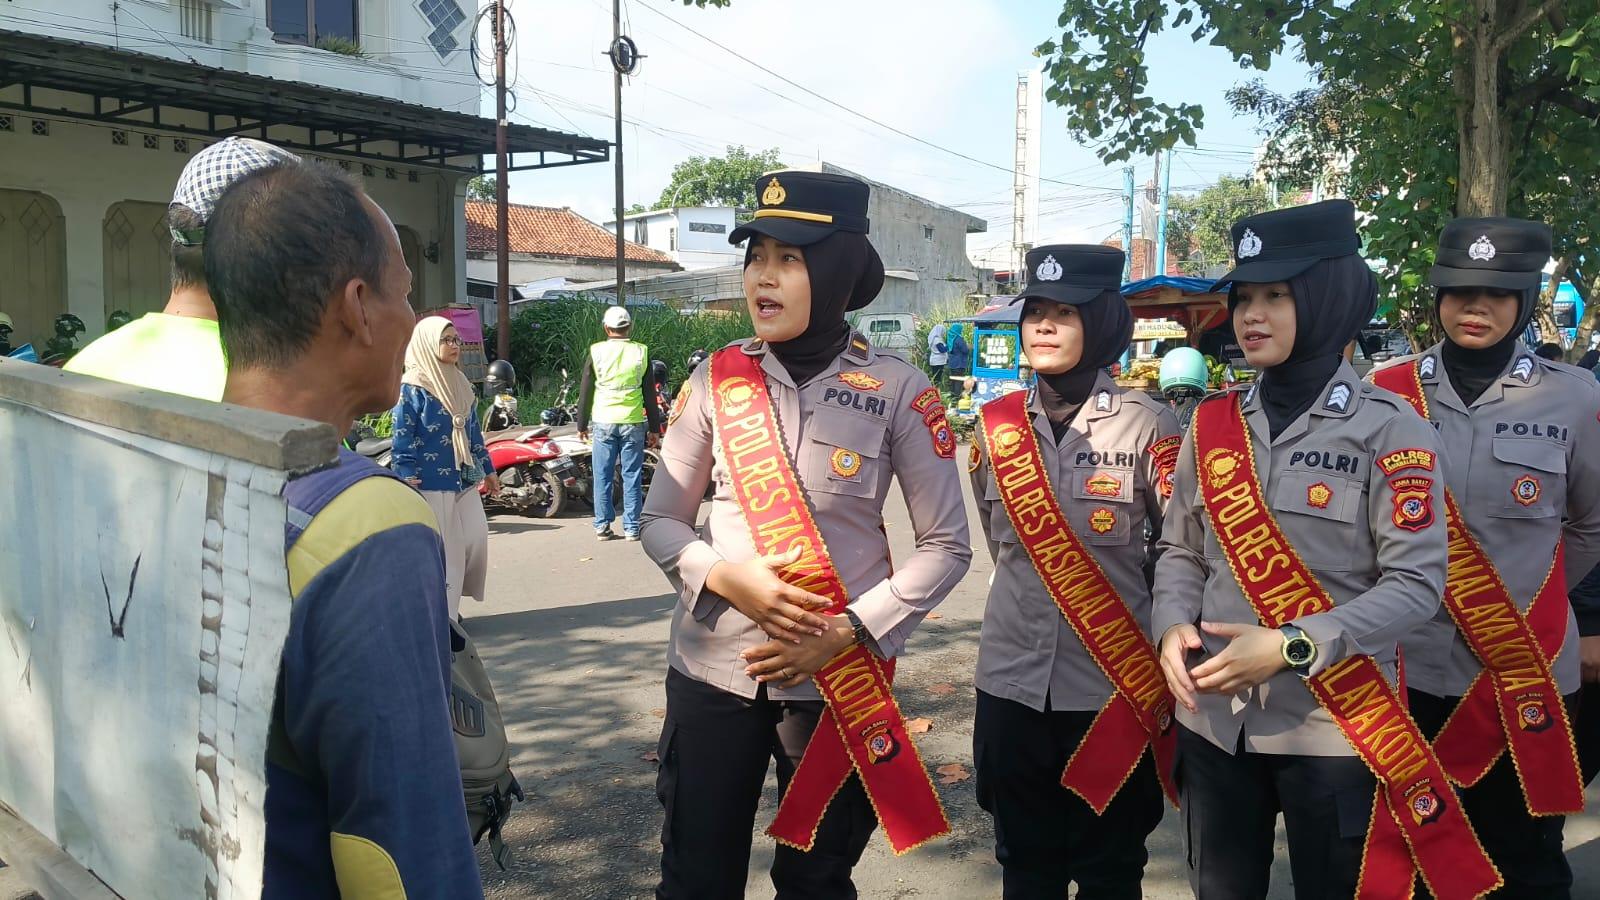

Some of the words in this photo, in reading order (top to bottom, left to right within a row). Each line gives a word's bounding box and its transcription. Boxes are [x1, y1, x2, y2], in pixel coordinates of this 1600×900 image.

[824, 387, 887, 416] POLRI
[1496, 422, 1568, 441] POLRI
[1076, 451, 1134, 467] POLRI
[1290, 450, 1359, 474] POLRI
[1383, 450, 1431, 467] POLRES
[723, 412, 792, 511] POLRES
[824, 656, 887, 729] KOTA
[997, 451, 1057, 536] POLRES
[1112, 647, 1166, 711] KOTA
[1211, 480, 1291, 583] POLRES
[1362, 715, 1430, 786] KOTA
[1483, 637, 1546, 692] KOTA
